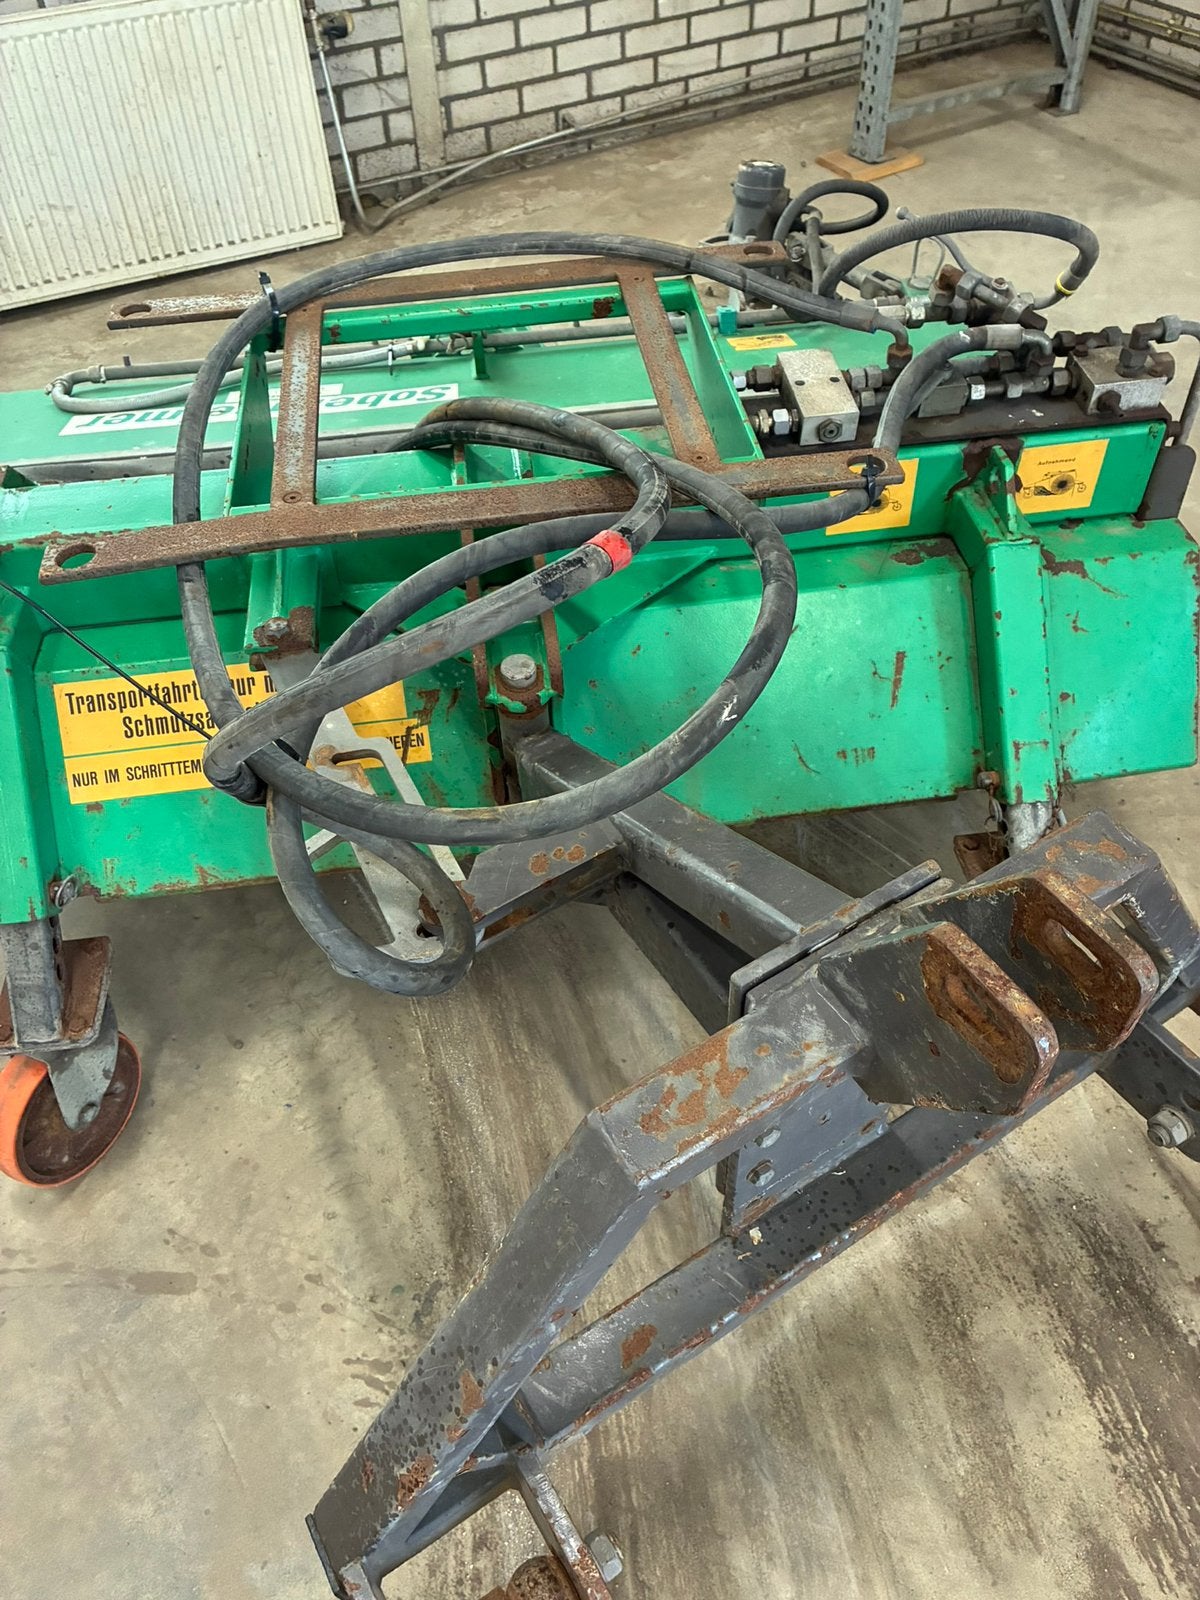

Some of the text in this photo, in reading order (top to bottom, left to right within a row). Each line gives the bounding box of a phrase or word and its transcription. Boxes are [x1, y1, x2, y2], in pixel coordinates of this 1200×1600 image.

[65, 681, 203, 715] Transportfahrt
[72, 771, 99, 788] NUR
[104, 769, 120, 784] IM
[126, 758, 203, 781] SCHRITTTEM
